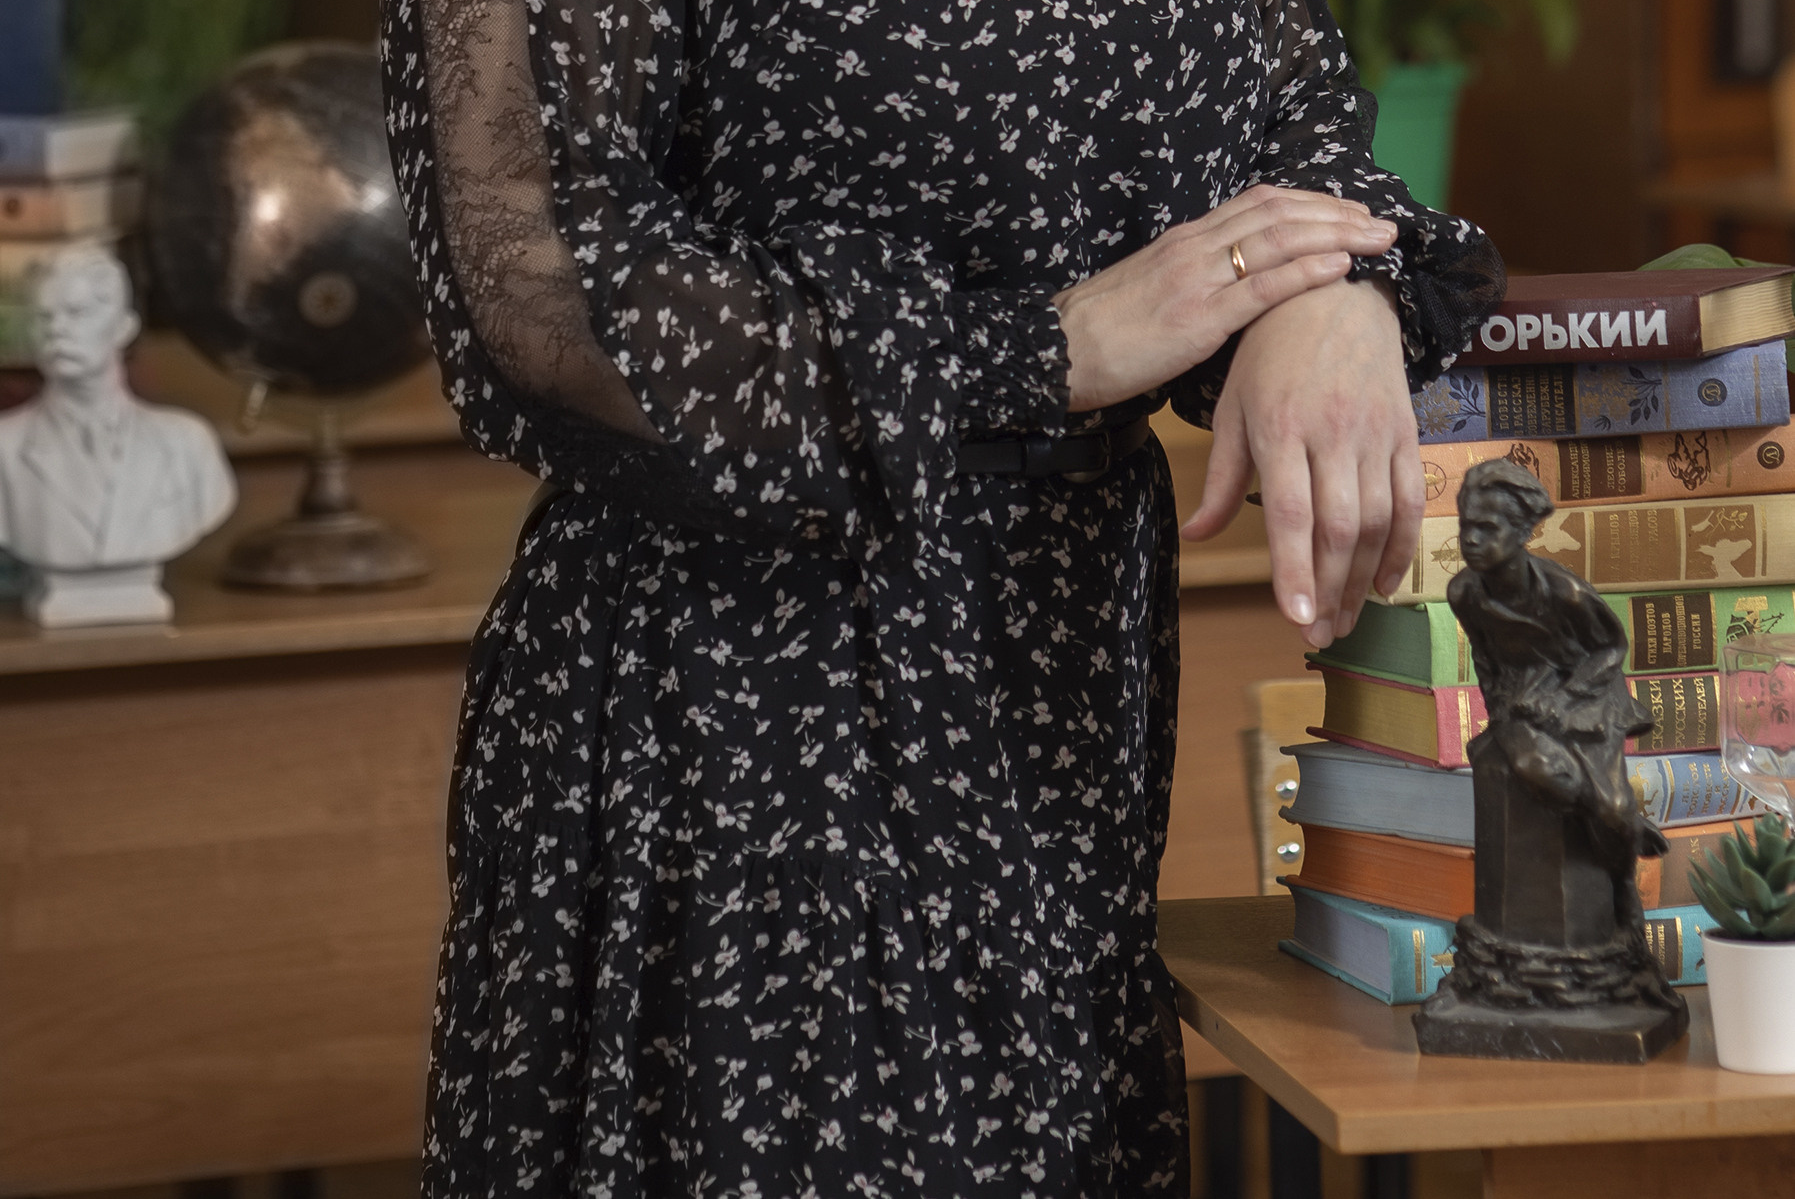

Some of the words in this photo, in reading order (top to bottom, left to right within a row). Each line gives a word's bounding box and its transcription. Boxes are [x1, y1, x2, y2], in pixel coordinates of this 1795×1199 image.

[1497, 374, 1509, 430] ПОВЕСТИ
[1645, 602, 1657, 636] ПОЭТОВ
[1661, 612, 1672, 654] НАРОДОВ
[1690, 613, 1702, 650] РОССИИ
[1647, 638, 1657, 664] СТИХИ
[1648, 679, 1664, 750] СКАЗКИ
[1672, 678, 1686, 748] РУССКИХ
[1693, 677, 1707, 747] ПИСАТЕЛЕЙ
